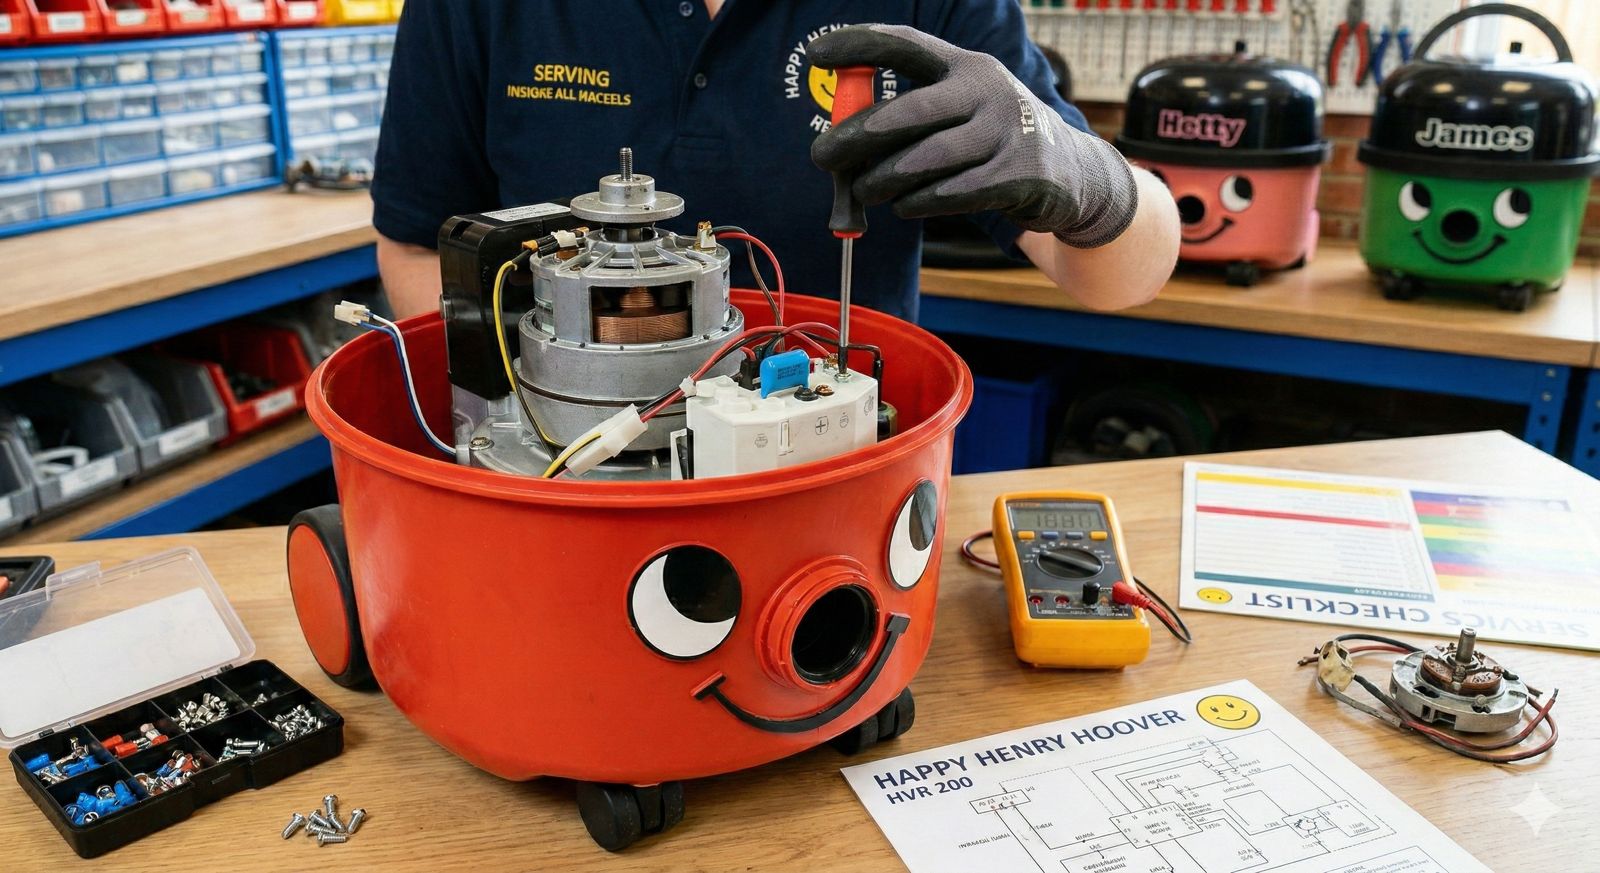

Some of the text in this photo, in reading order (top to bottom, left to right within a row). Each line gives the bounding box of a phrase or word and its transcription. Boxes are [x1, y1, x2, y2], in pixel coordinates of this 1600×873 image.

[534, 64, 610, 87] SERVING
[784, 41, 806, 99] HAPPY
[554, 88, 577, 100] ALL
[1157, 109, 1247, 148] Hetty
[1415, 117, 1535, 152] James
[1245, 592, 1430, 623] CHECKLIST
[873, 709, 1187, 789] HAPPY HENRY HOOVER
[886, 776, 973, 804] HVR 200
